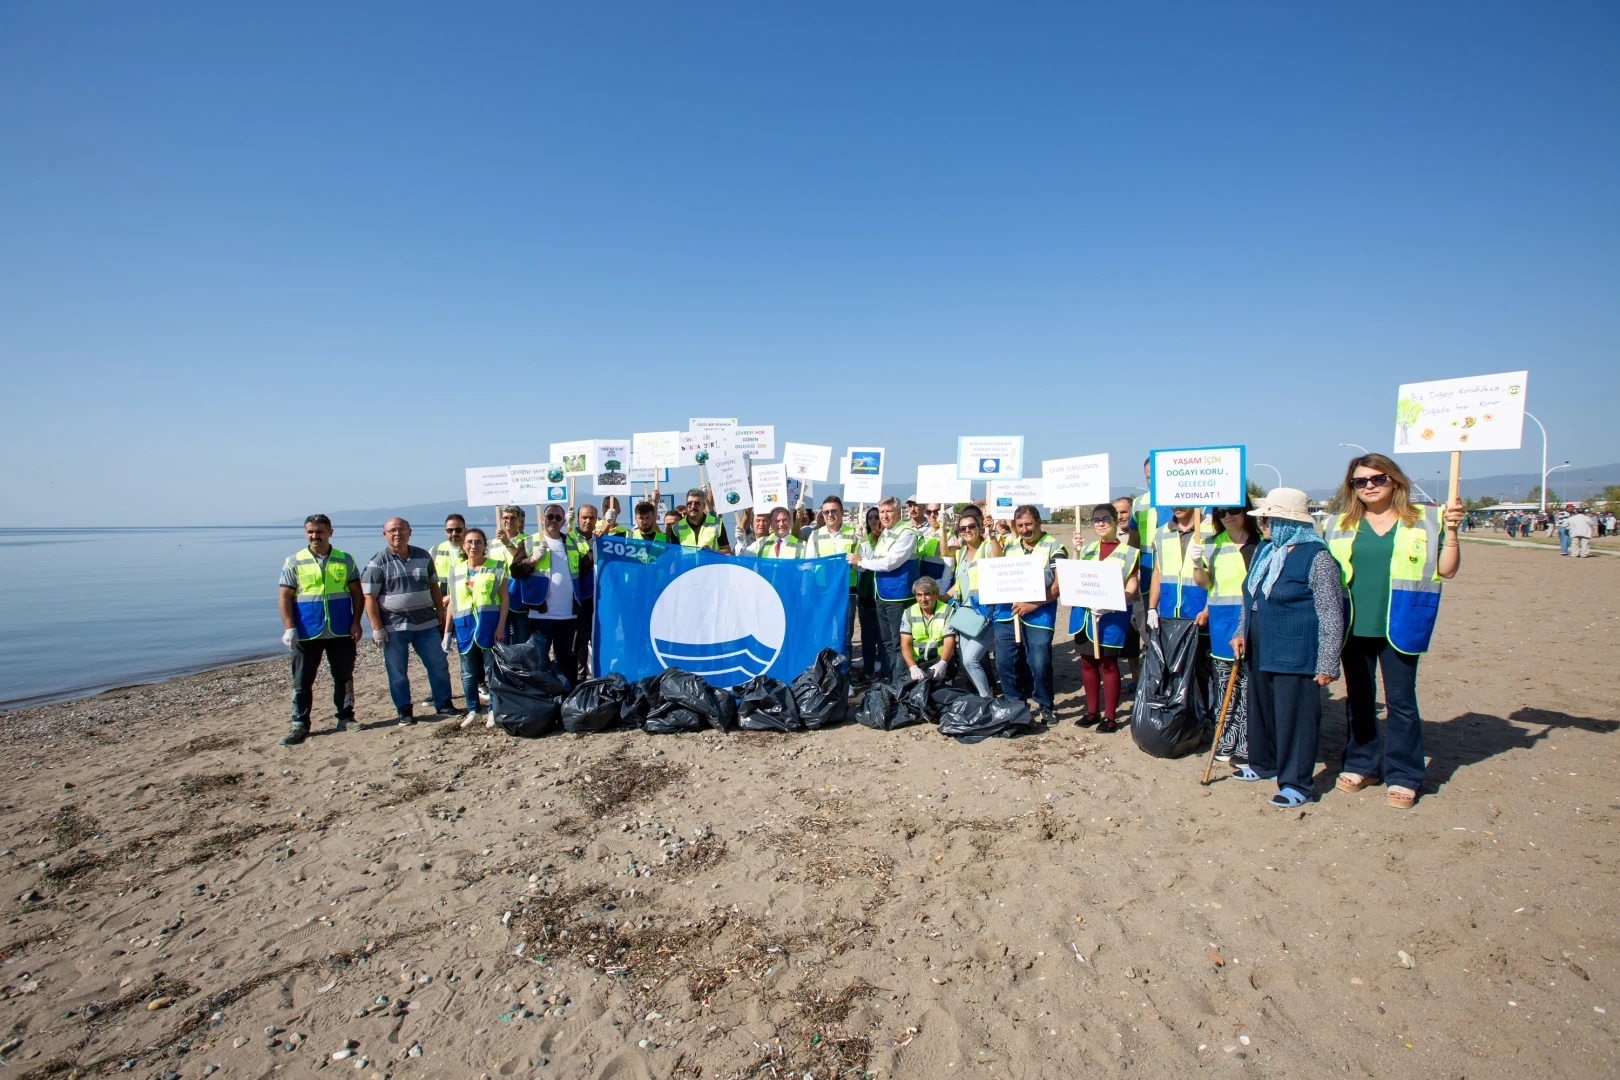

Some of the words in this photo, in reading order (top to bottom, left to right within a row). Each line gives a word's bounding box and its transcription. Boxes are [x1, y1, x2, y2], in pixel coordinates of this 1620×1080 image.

[1173, 458, 1202, 466] YAŞAM
[1204, 455, 1222, 465] İÇİN
[1166, 468, 1198, 476] DOĞAYI
[1178, 479, 1216, 488] GELECEĞİ
[602, 540, 648, 560] 2024
